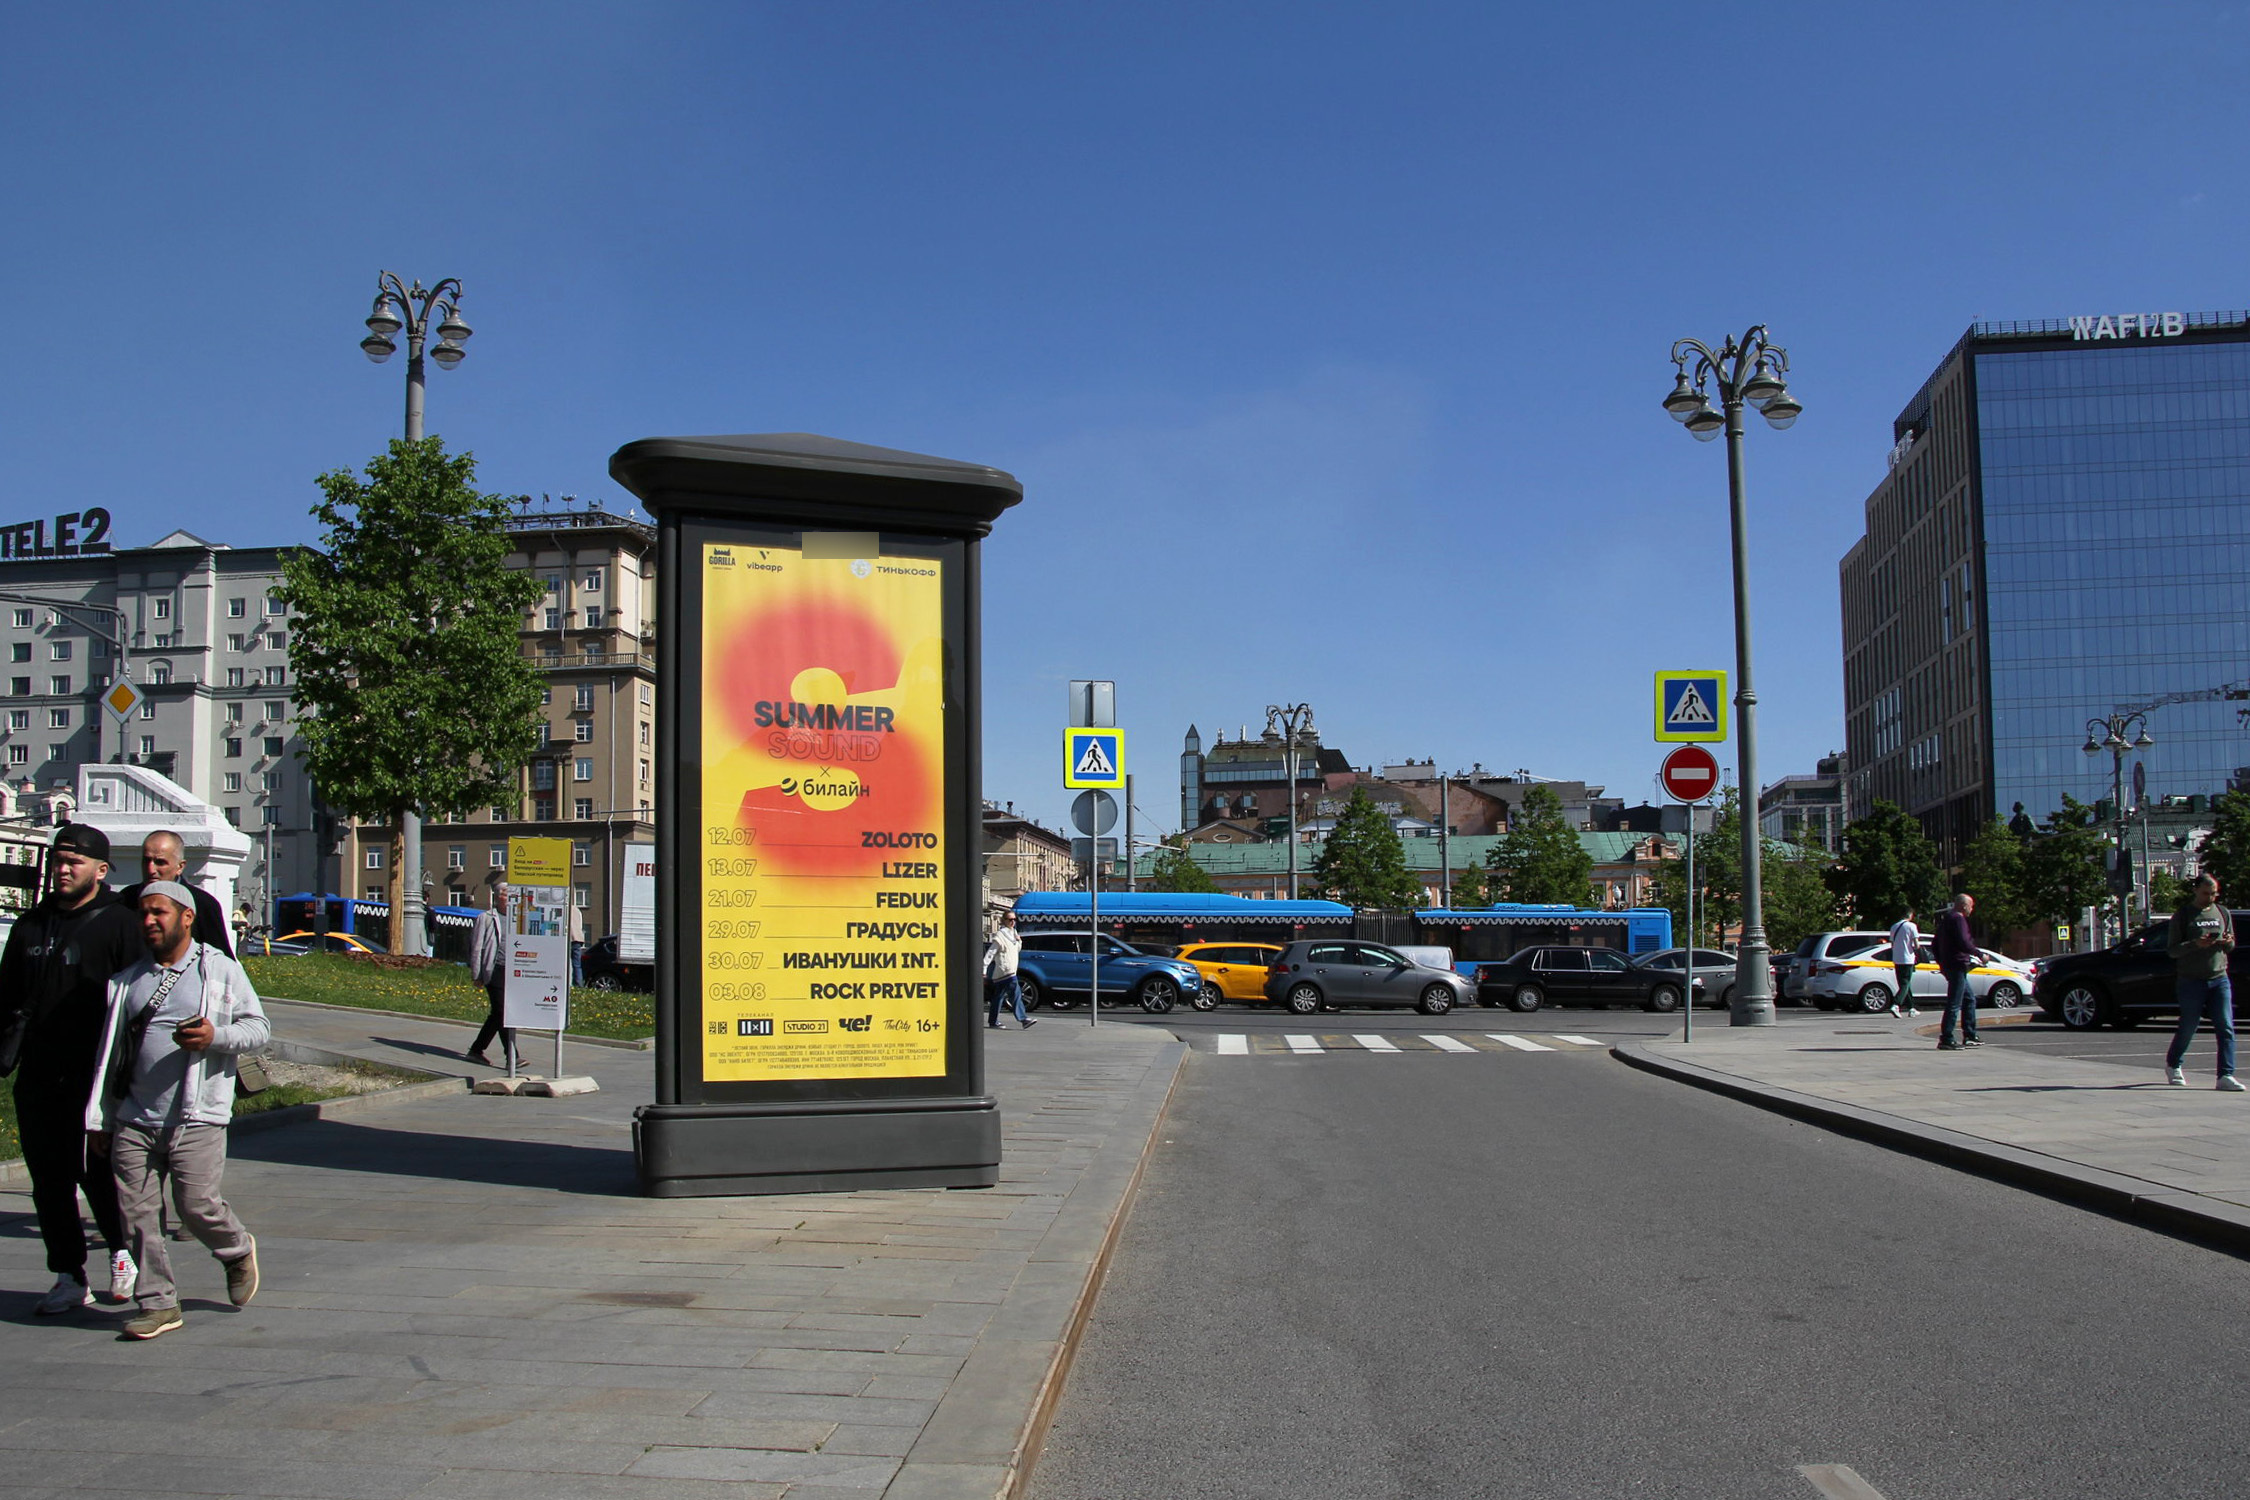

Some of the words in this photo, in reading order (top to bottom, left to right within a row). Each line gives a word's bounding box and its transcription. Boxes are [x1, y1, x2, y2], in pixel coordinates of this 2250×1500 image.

[0, 507, 111, 558] TELE2
[708, 555, 736, 566] GORILLA
[746, 562, 783, 573] vibeapp
[876, 565, 936, 577] ТИНЬКОФФ
[754, 700, 895, 733] SUMMER
[768, 732, 882, 761] SOUND
[803, 778, 870, 798] билайн
[707, 827, 757, 846] 12.07
[861, 831, 938, 849] ZOLOTO
[707, 858, 757, 876] 13.07
[882, 862, 938, 879] LIZER
[707, 889, 757, 907] 21.07
[876, 892, 938, 908] FEDUK
[707, 920, 761, 938] 29.07
[846, 922, 938, 941] ГРАДУСЫ
[707, 951, 764, 970] 30.07
[783, 952, 896, 969] ИВАНУШКИ
[901, 952, 939, 969] INT.
[158, 972, 181, 995] 1980
[708, 982, 766, 1001] 03.08
[810, 983, 866, 999] ROCK
[869, 982, 939, 999] PRIVET
[787, 1023, 815, 1031] STUDIO
[818, 1023, 826, 1031] 21
[916, 1019, 940, 1032] 16+
